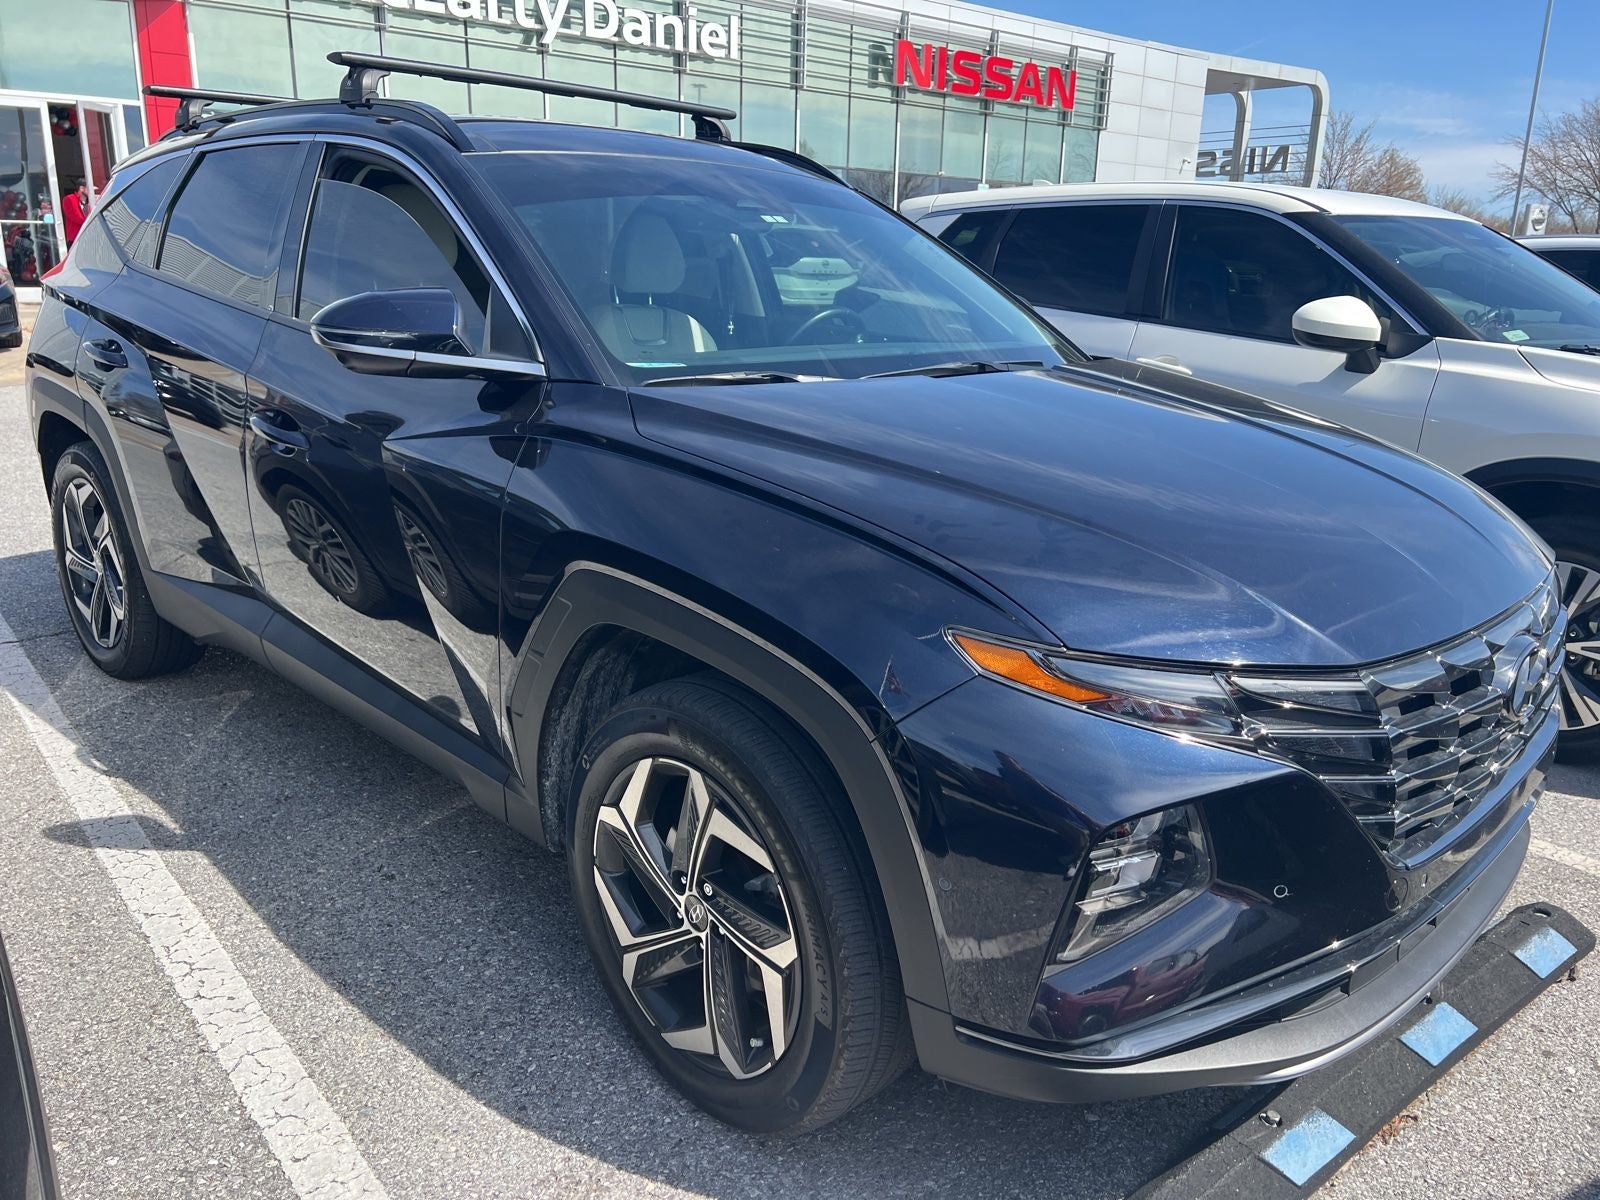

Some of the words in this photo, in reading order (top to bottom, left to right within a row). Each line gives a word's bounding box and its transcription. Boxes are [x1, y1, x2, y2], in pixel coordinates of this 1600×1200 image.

[585, 0, 739, 60] Daniel
[896, 38, 1077, 110] NISSAN
[801, 901, 828, 990] PRIMACY
